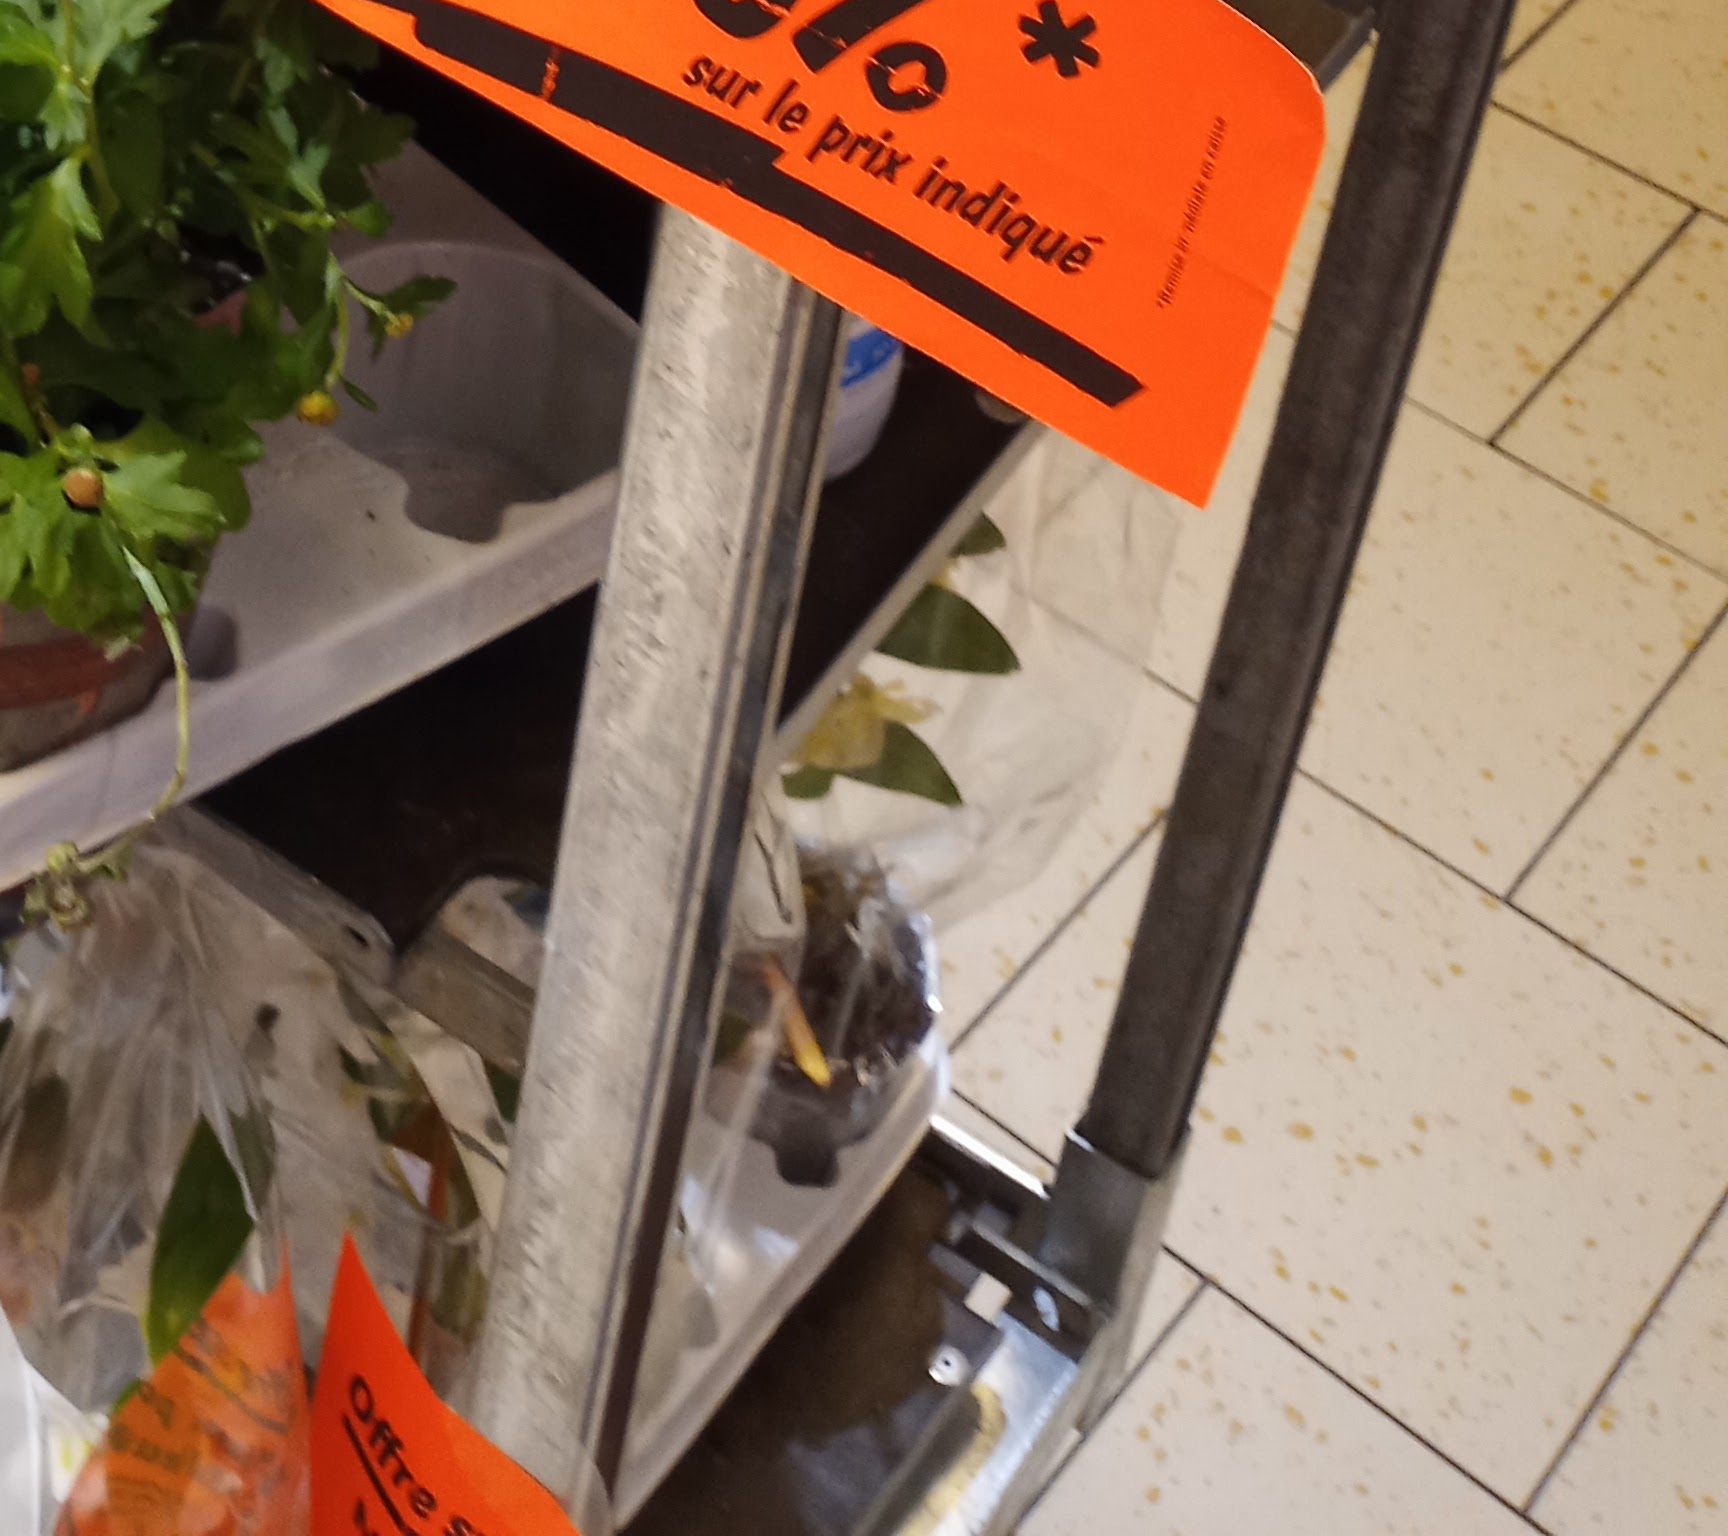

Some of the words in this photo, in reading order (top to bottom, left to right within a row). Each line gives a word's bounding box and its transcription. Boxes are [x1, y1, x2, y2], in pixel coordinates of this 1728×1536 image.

[682, 54, 763, 110] sur
[764, 78, 809, 134] le
[804, 113, 913, 186] prix
[912, 155, 1106, 276] indiqué
[348, 1374, 438, 1520] Offre
